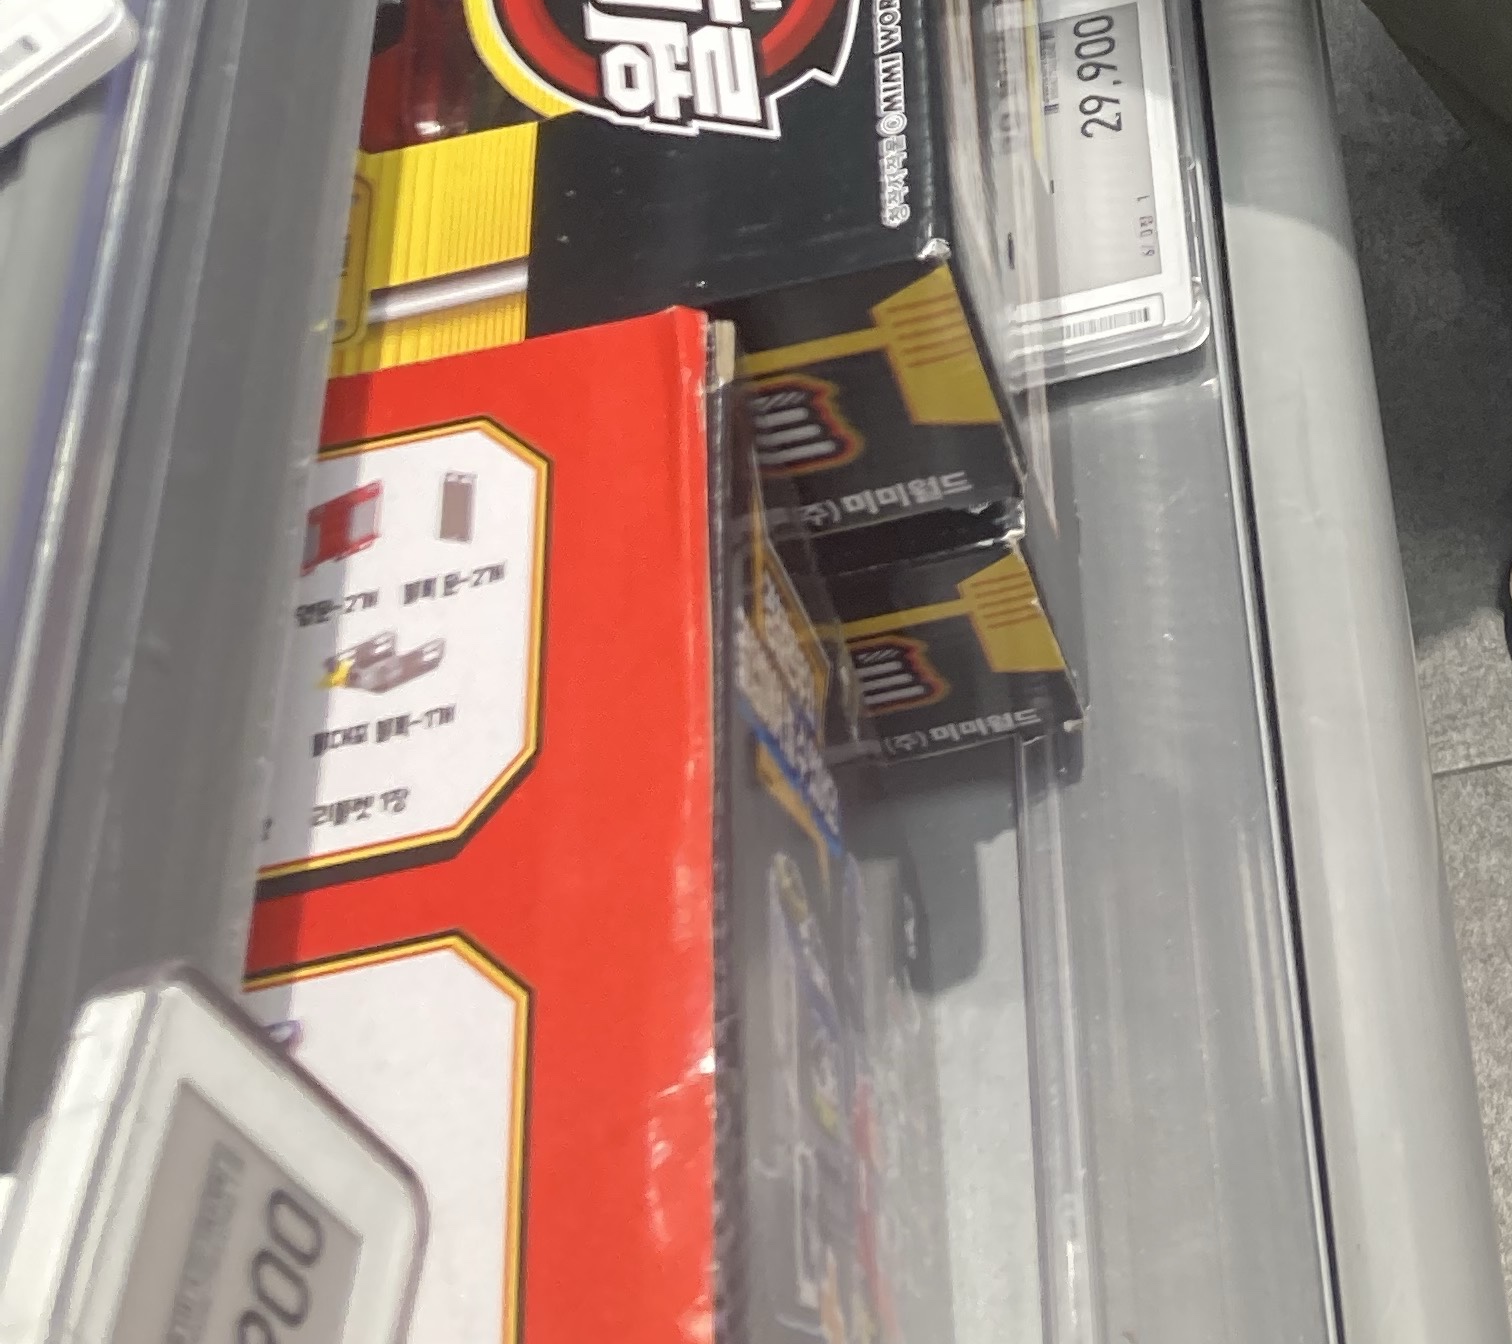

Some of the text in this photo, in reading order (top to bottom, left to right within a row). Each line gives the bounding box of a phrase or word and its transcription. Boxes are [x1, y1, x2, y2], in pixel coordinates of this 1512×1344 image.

[1074, 13, 1124, 142] 29,900
[840, 470, 973, 516] 미미월드
[929, 707, 1041, 742] 미미월드
